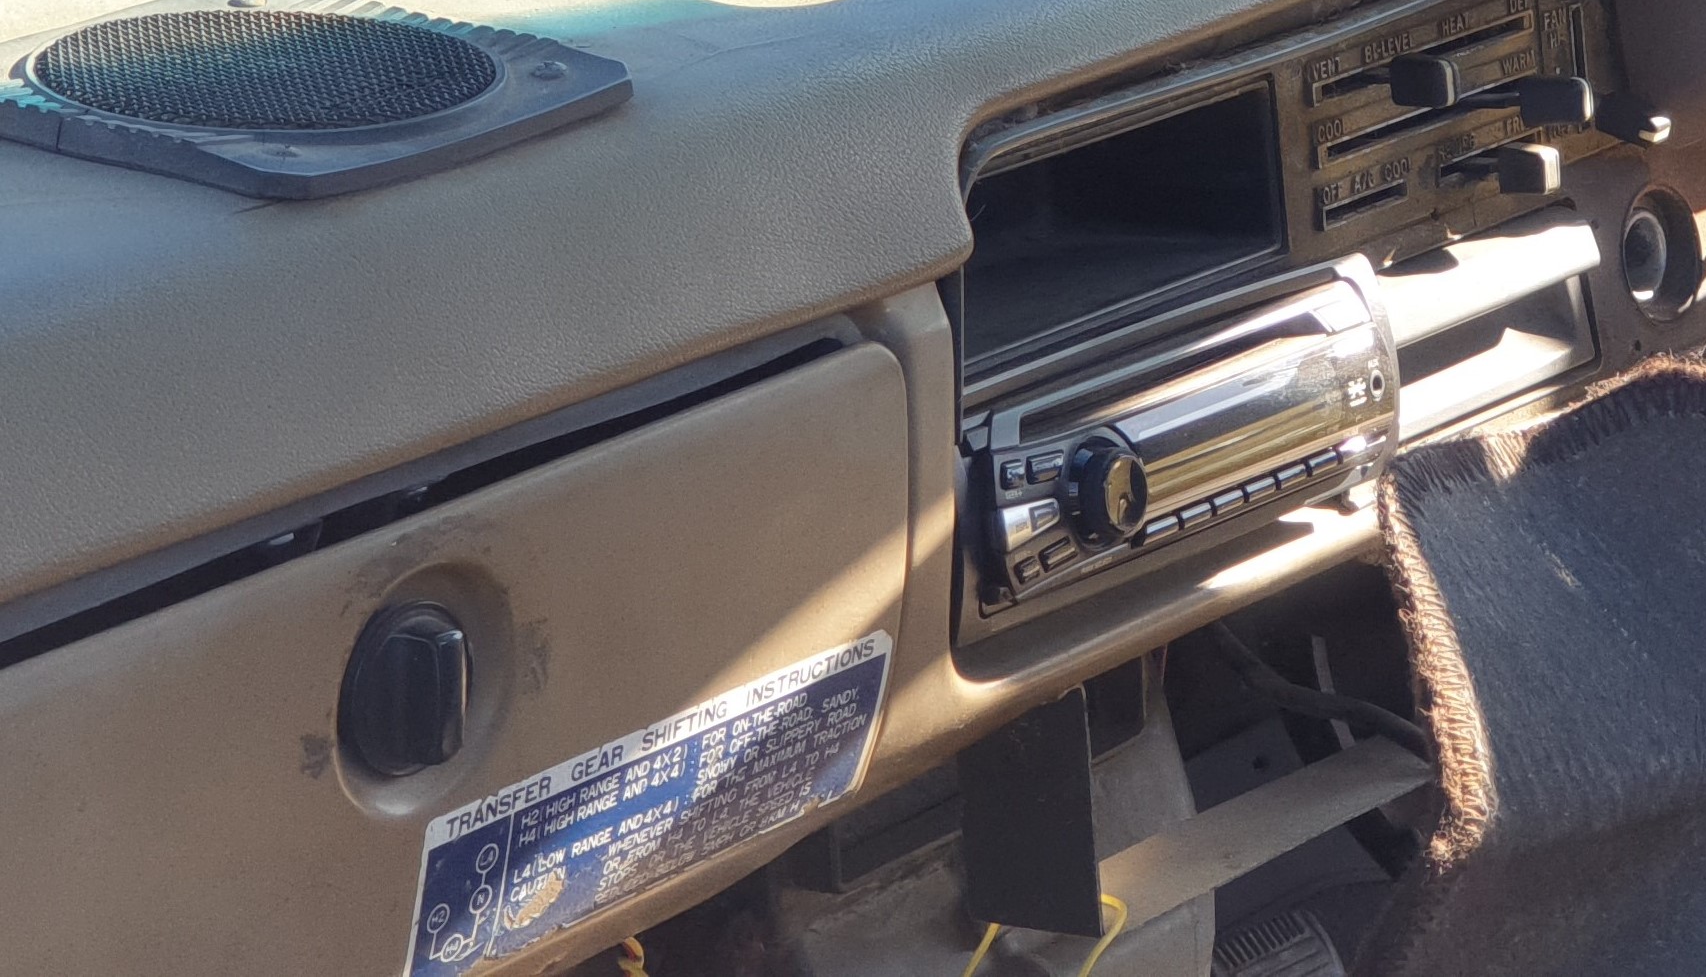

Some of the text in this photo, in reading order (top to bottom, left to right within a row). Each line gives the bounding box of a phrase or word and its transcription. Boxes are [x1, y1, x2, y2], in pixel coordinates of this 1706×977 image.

[1544, 6, 1566, 32] FAN
[1313, 56, 1341, 82] VENT
[1502, 49, 1536, 76] WARM
[1318, 118, 1348, 143] COOL
[445, 640, 874, 837] TRANSFER GEAR SHIFTING INSTRUCTIONS
[580, 775, 619, 803] RANGE
[626, 762, 649, 782] AND
[653, 745, 686, 770] 4X2)
[701, 728, 725, 750] FOR
[732, 693, 806, 736] ON-THE-ROAD
[697, 703, 855, 784] SNOWY OR SLIPPERY ROAD
[571, 828, 611, 857] RANGE
[693, 780, 716, 801] FOR
[724, 767, 745, 787] THE
[813, 713, 866, 747] TRACTION
[577, 792, 617, 821] RANGE
[623, 780, 645, 800] AND
[651, 762, 684, 788] 4X4)
[698, 745, 722, 767] FOR
[800, 783, 810, 796] IS
[510, 866, 564, 904] CAUTIN
[679, 788, 736, 825] SHIFTING
[745, 771, 775, 794] FROM
[806, 752, 818, 766] TO
[603, 857, 619, 875] OR
[691, 817, 704, 833] TO
